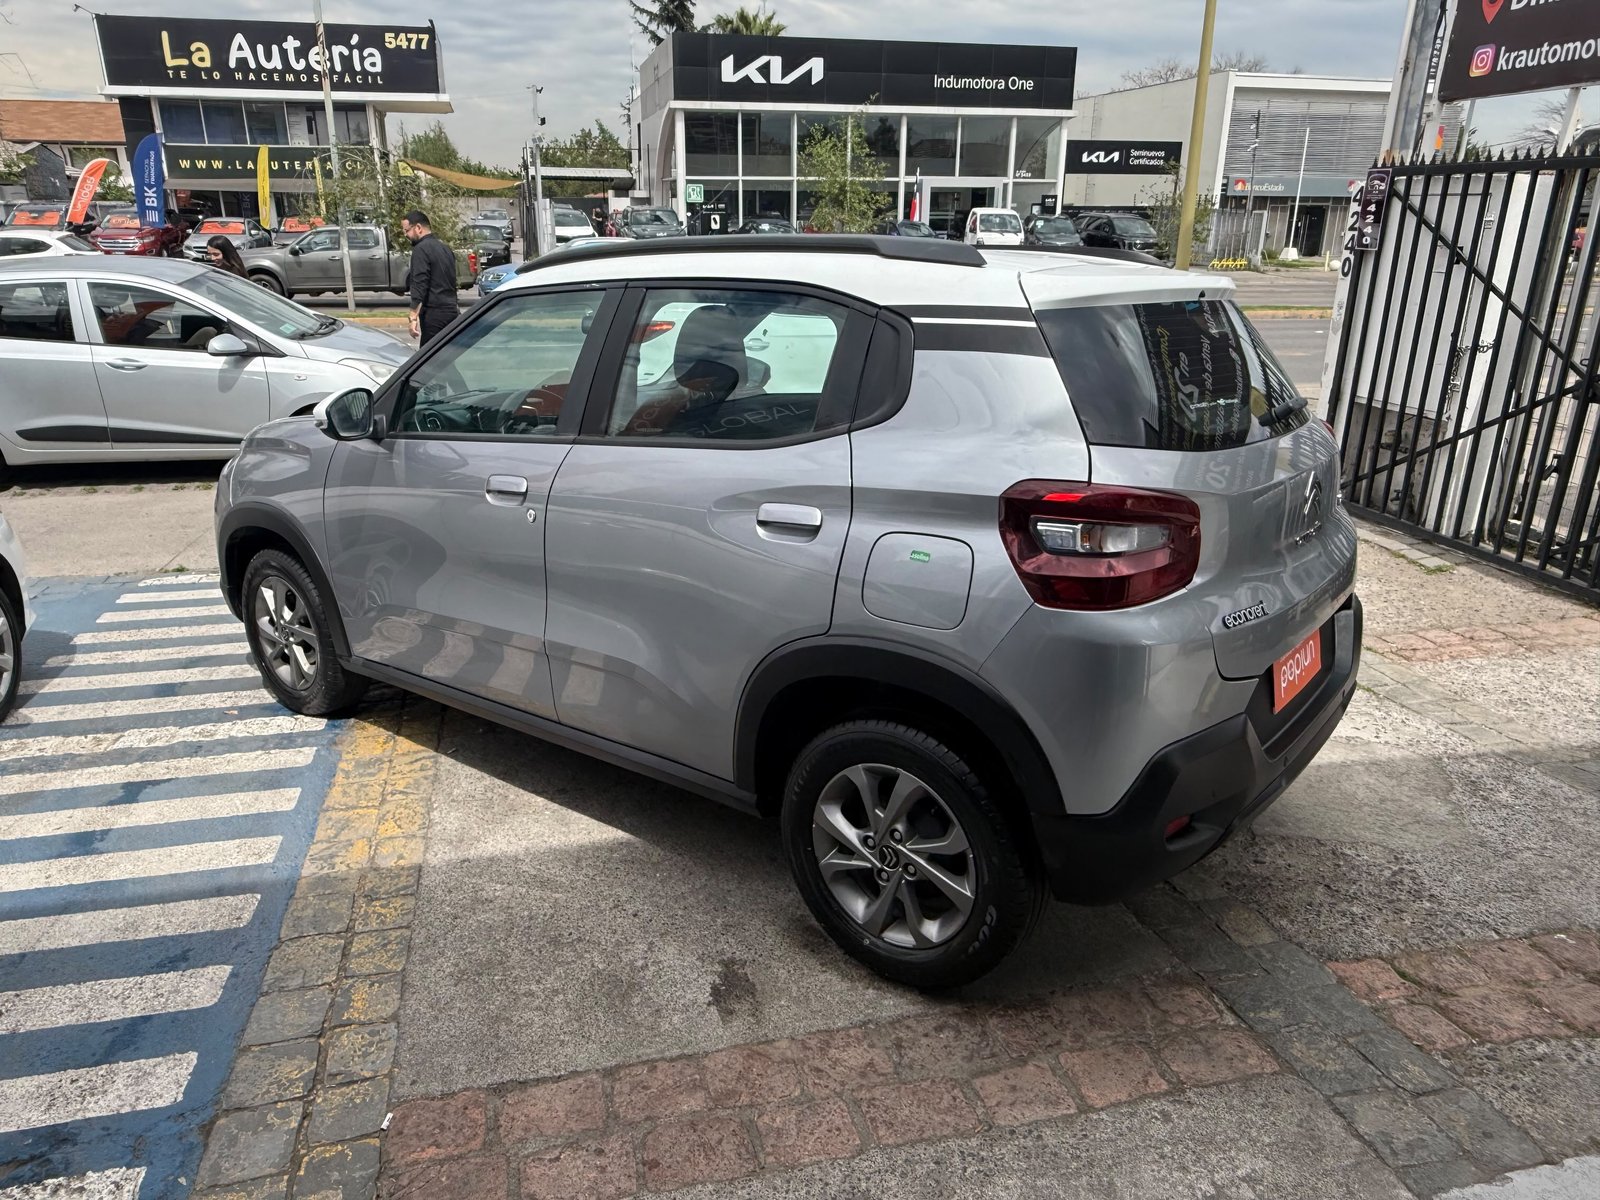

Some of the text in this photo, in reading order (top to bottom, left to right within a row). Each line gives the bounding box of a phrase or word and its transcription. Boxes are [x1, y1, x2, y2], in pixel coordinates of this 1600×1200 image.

[384, 32, 429, 50] 5477
[161, 30, 382, 72] La Autería
[1496, 38, 1600, 71] krautomo
[167, 70, 383, 84] TE LO HACEMOS FÁCIL
[721, 54, 824, 85] KIA
[933, 74, 1034, 90] Indumotora One
[1081, 151, 1120, 163] KIA
[1129, 157, 1164, 165] Certificados
[1130, 149, 1165, 157] Seminuevos
[144, 186, 157, 207] BK
